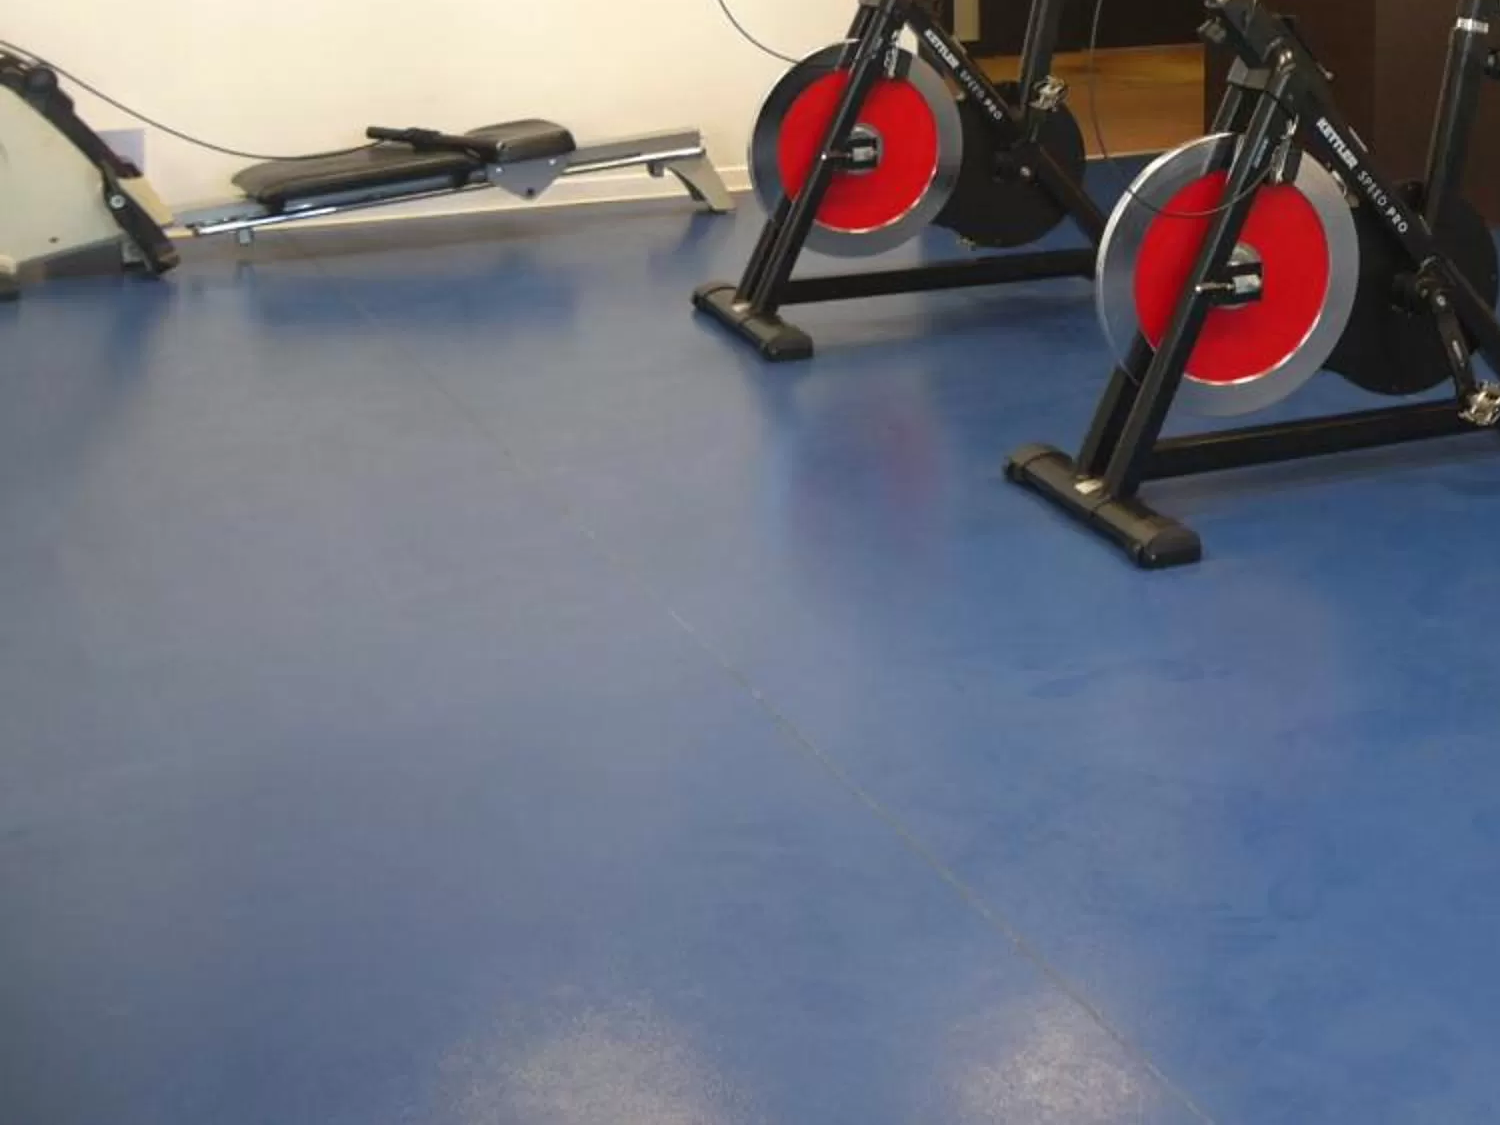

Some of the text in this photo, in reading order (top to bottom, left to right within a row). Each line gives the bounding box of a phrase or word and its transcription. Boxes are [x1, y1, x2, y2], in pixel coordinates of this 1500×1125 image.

[924, 28, 960, 70] KETTLER
[983, 98, 1003, 120] PRO
[1316, 116, 1408, 233] KETTLER SPEED PRO
